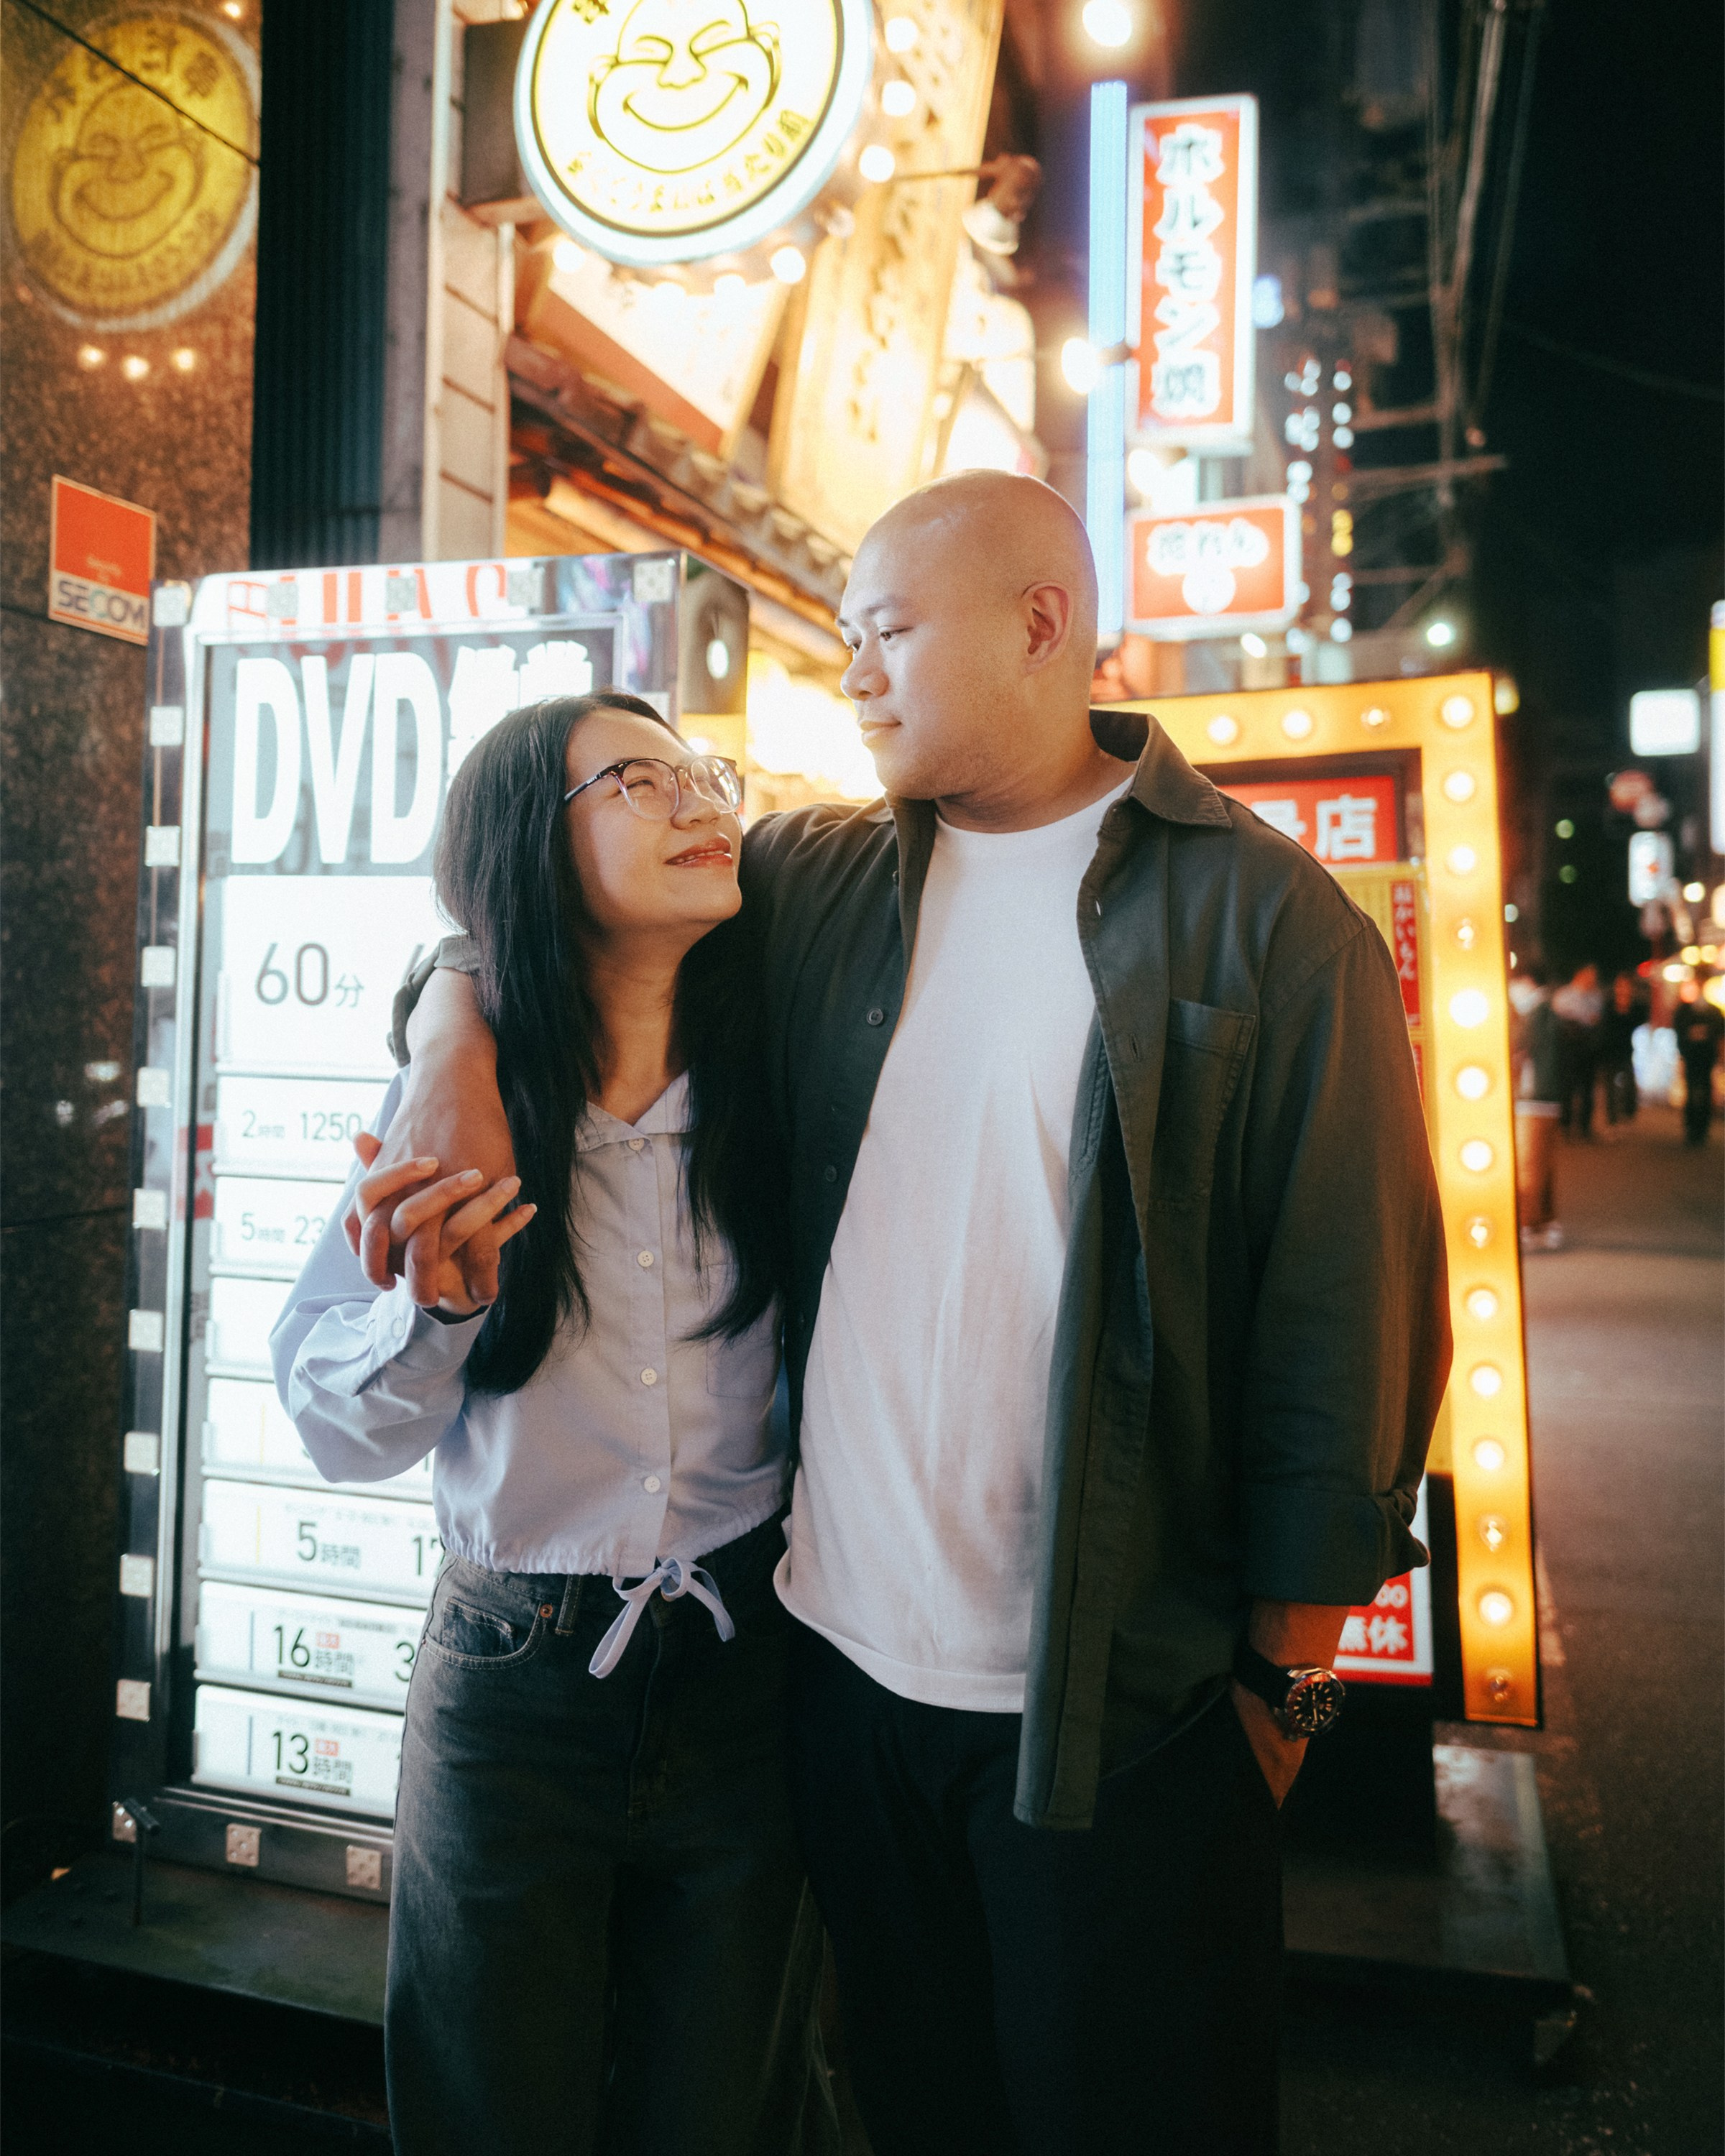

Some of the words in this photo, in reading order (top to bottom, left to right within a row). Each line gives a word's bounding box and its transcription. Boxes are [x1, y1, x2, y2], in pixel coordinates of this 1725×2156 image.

[58, 579, 144, 628] SECOM
[256, 942, 364, 1007] 60分
[300, 1112, 362, 1141] 1250
